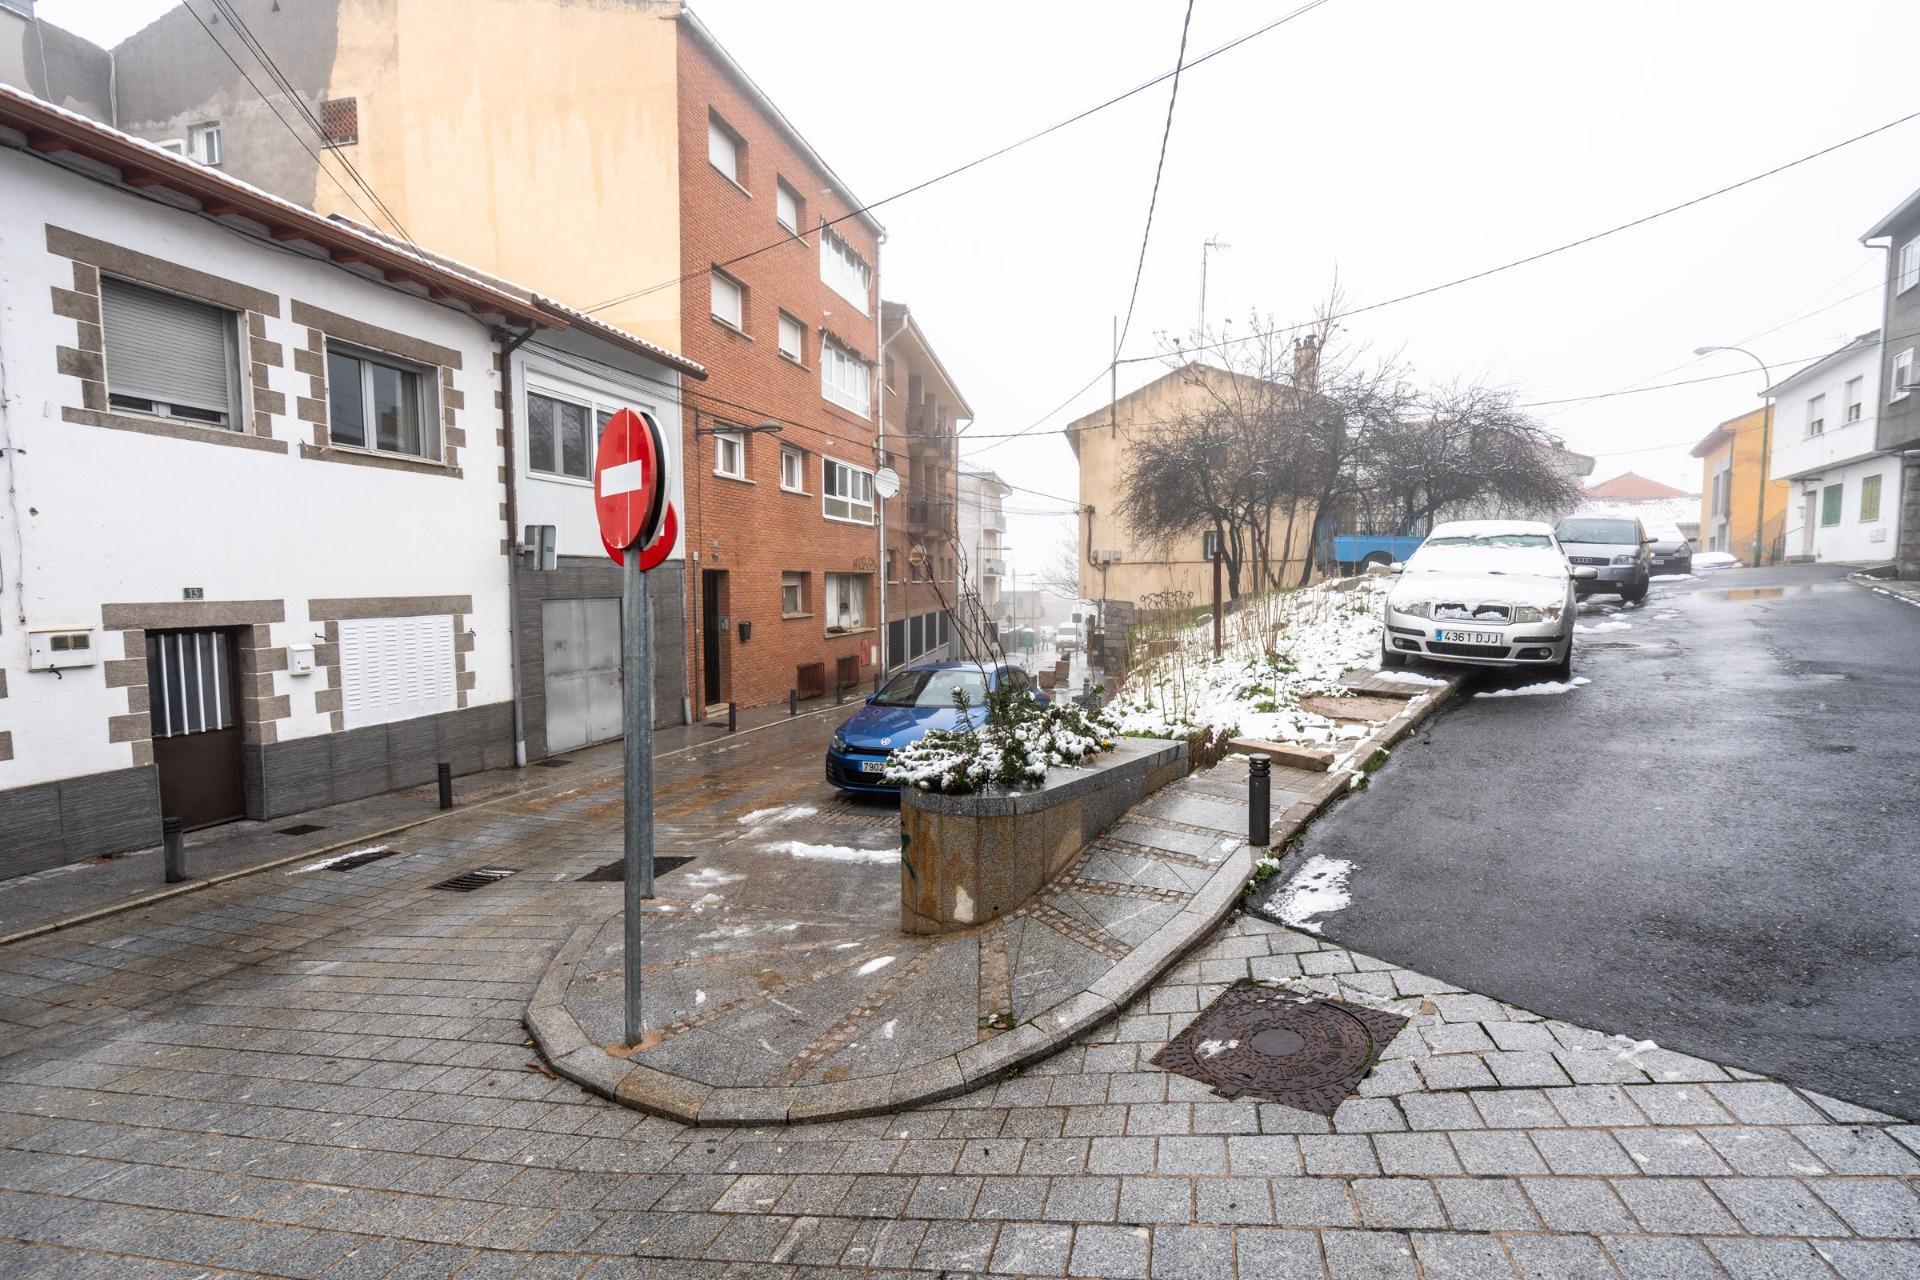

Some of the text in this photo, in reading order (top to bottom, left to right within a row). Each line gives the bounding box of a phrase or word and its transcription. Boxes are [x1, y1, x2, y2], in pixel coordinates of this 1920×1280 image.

[1444, 631, 1498, 644] 4361 DJJ
[864, 762, 884, 772] 7902
